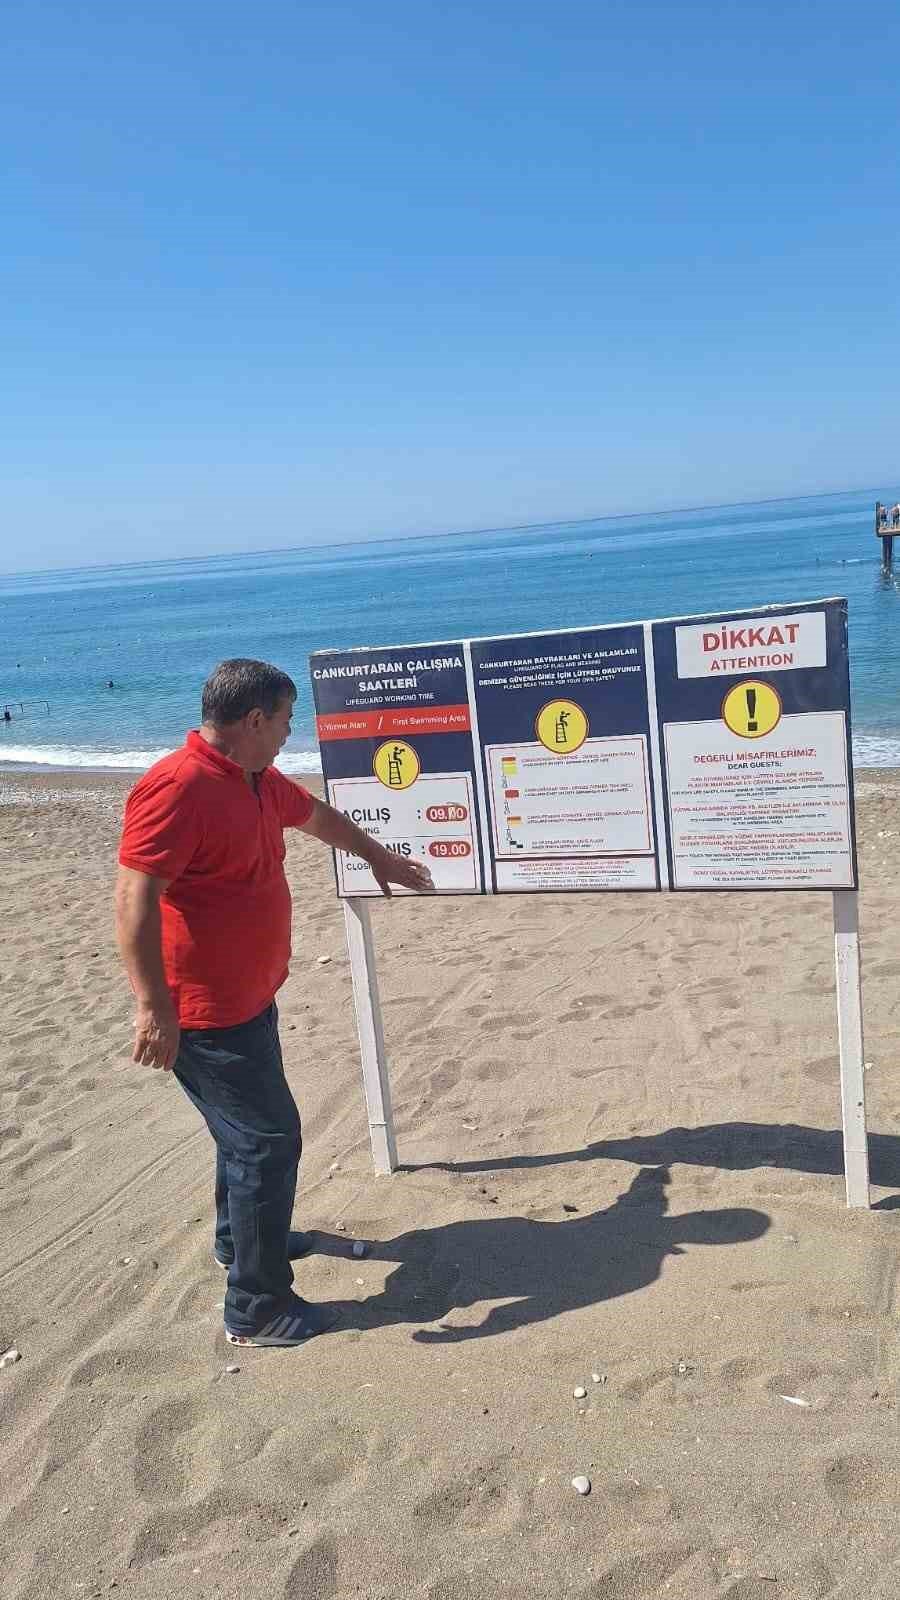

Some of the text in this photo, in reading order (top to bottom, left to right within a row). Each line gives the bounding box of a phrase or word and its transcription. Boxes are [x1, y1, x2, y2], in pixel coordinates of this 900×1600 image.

[703, 624, 799, 651] DİKKAT
[479, 659, 532, 669] CANKURTARAN
[534, 654, 581, 664] BAYRAKLARI
[594, 648, 638, 658] ANLAMLARI
[710, 653, 793, 671] ATTENTION
[313, 657, 463, 679] CANKURTARAN ÇALIŞMA
[359, 675, 417, 692] SAATLERİ
[345, 696, 383, 706] LIFEGUARD
[384, 694, 416, 703] WORKING
[449, 714, 466, 723] Area
[727, 762, 748, 770] DEAR
[434, 844, 467, 856] 19.00
